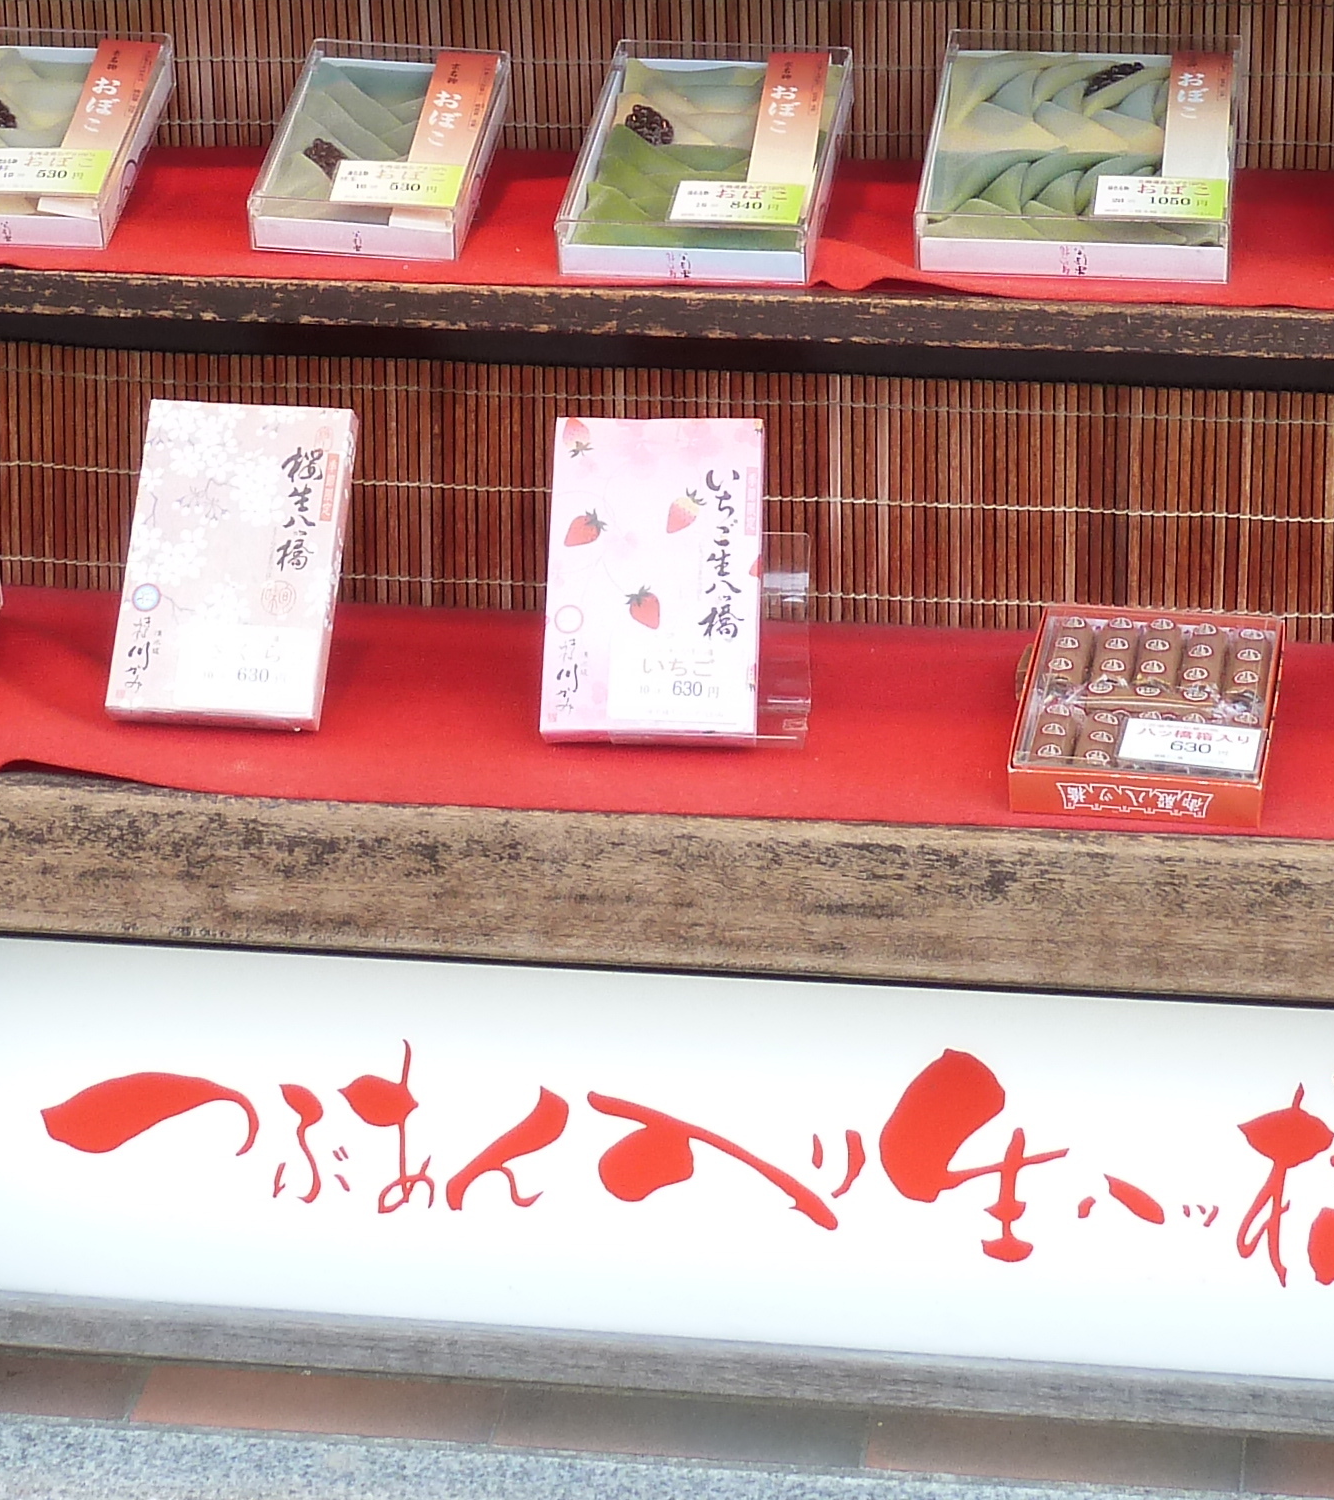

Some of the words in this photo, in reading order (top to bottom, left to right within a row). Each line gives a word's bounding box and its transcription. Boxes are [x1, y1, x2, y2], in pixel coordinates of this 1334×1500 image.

[1177, 71, 1209, 120] おぼこ
[83, 76, 122, 133] おぼこ
[767, 83, 802, 135] おぼこ
[428, 90, 463, 147] おぼこ
[23, 155, 95, 169] おぼこ
[36, 169, 68, 180] 530
[375, 168, 446, 182] おぼこ
[389, 183, 421, 193] 530
[716, 188, 788, 201] おぼこ
[1137, 184, 1211, 197] おぼこ
[730, 201, 763, 211] 840
[1148, 196, 1192, 207] 1050
[642, 656, 716, 678] いちご
[236, 668, 270, 683] 630
[671, 680, 703, 698] 630
[1170, 741, 1212, 754] 630
